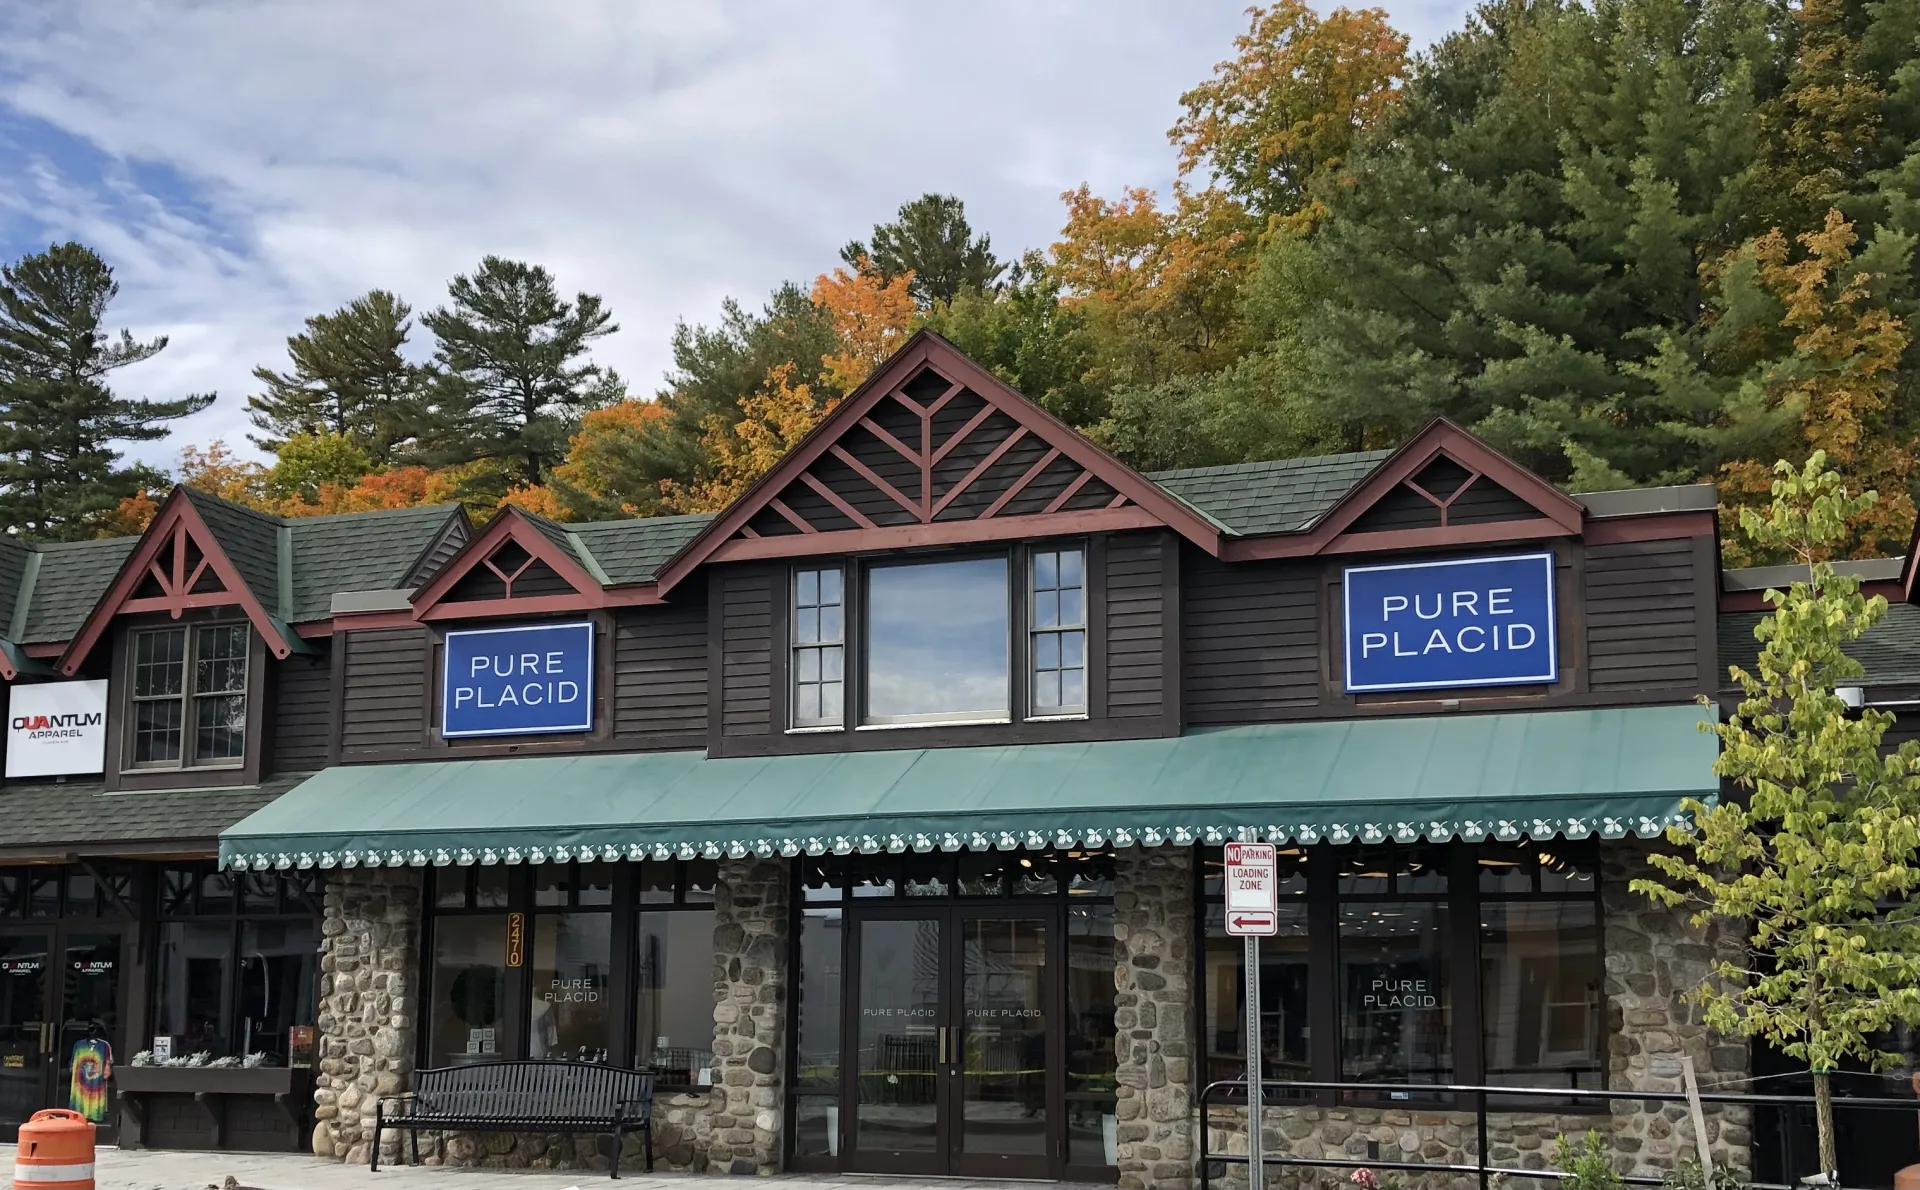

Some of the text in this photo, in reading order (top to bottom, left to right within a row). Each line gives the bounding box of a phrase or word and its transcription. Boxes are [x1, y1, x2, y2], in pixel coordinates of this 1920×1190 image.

[1383, 588, 1514, 622] PURE
[1362, 623, 1536, 659] PLACID
[471, 652, 564, 678] PURE
[455, 681, 579, 709] PLACID
[13, 712, 102, 733] QUANTUM
[28, 729, 83, 739] APPAREL
[1228, 847, 1272, 862] NO PARKING
[1233, 869, 1269, 878] LOADING
[1240, 881, 1262, 890] ZONE
[510, 914, 520, 965] 2470
[74, 961, 112, 969] QNTUM
[551, 979, 592, 989] PURE
[1372, 980, 1426, 992] PURE
[544, 992, 598, 1002] PLACID
[1364, 995, 1436, 1007] PLACID
[863, 1008, 936, 1017] PURE PLACID
[967, 1009, 1041, 1017] PURE PLACID
